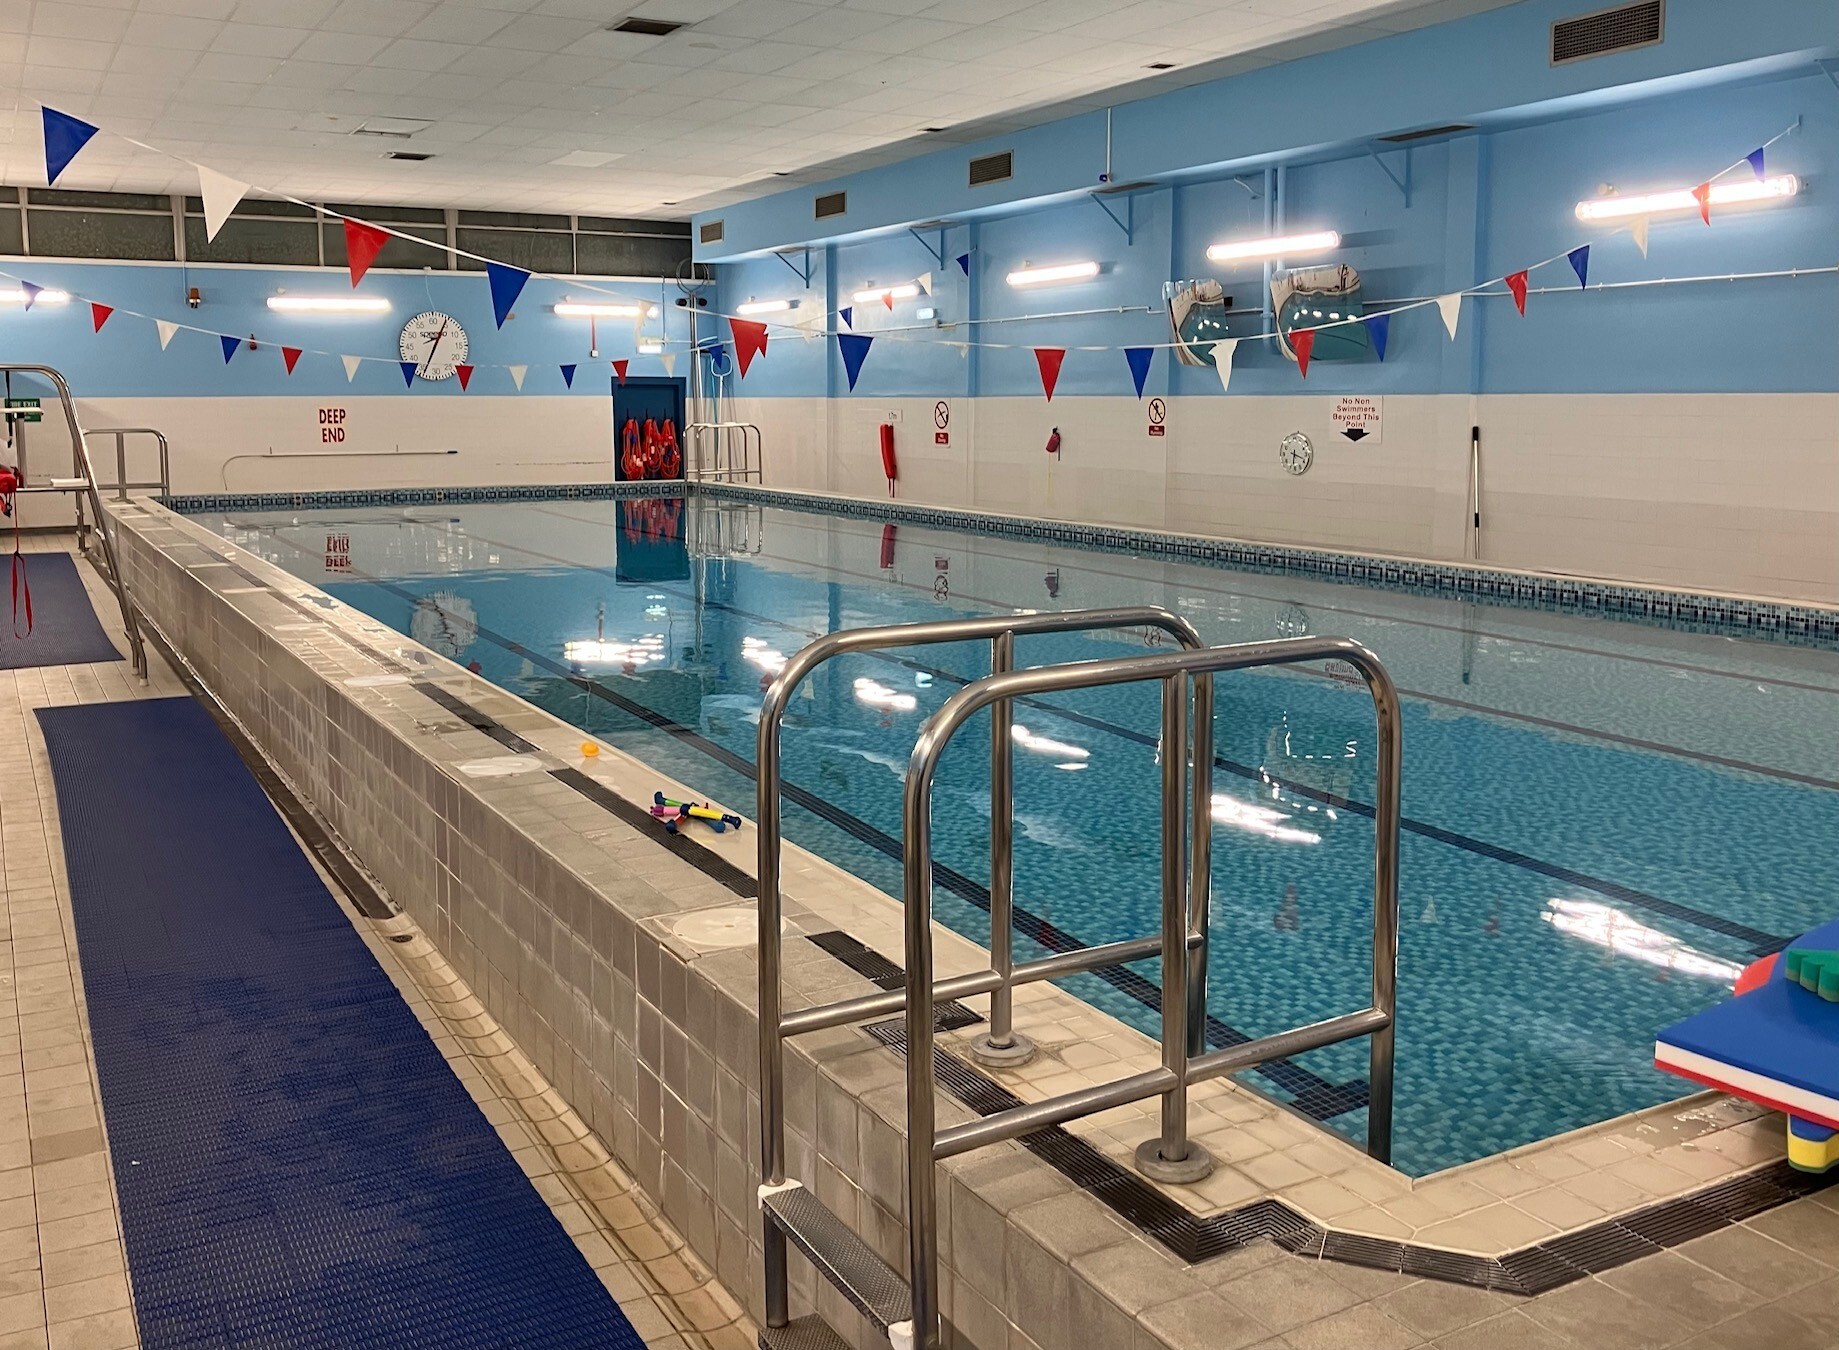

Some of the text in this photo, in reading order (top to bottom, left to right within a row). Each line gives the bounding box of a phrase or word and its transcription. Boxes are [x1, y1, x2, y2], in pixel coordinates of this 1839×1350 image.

[319, 409, 346, 424] DEEP
[1333, 413, 1361, 421] Beyond
[322, 428, 345, 443] END
